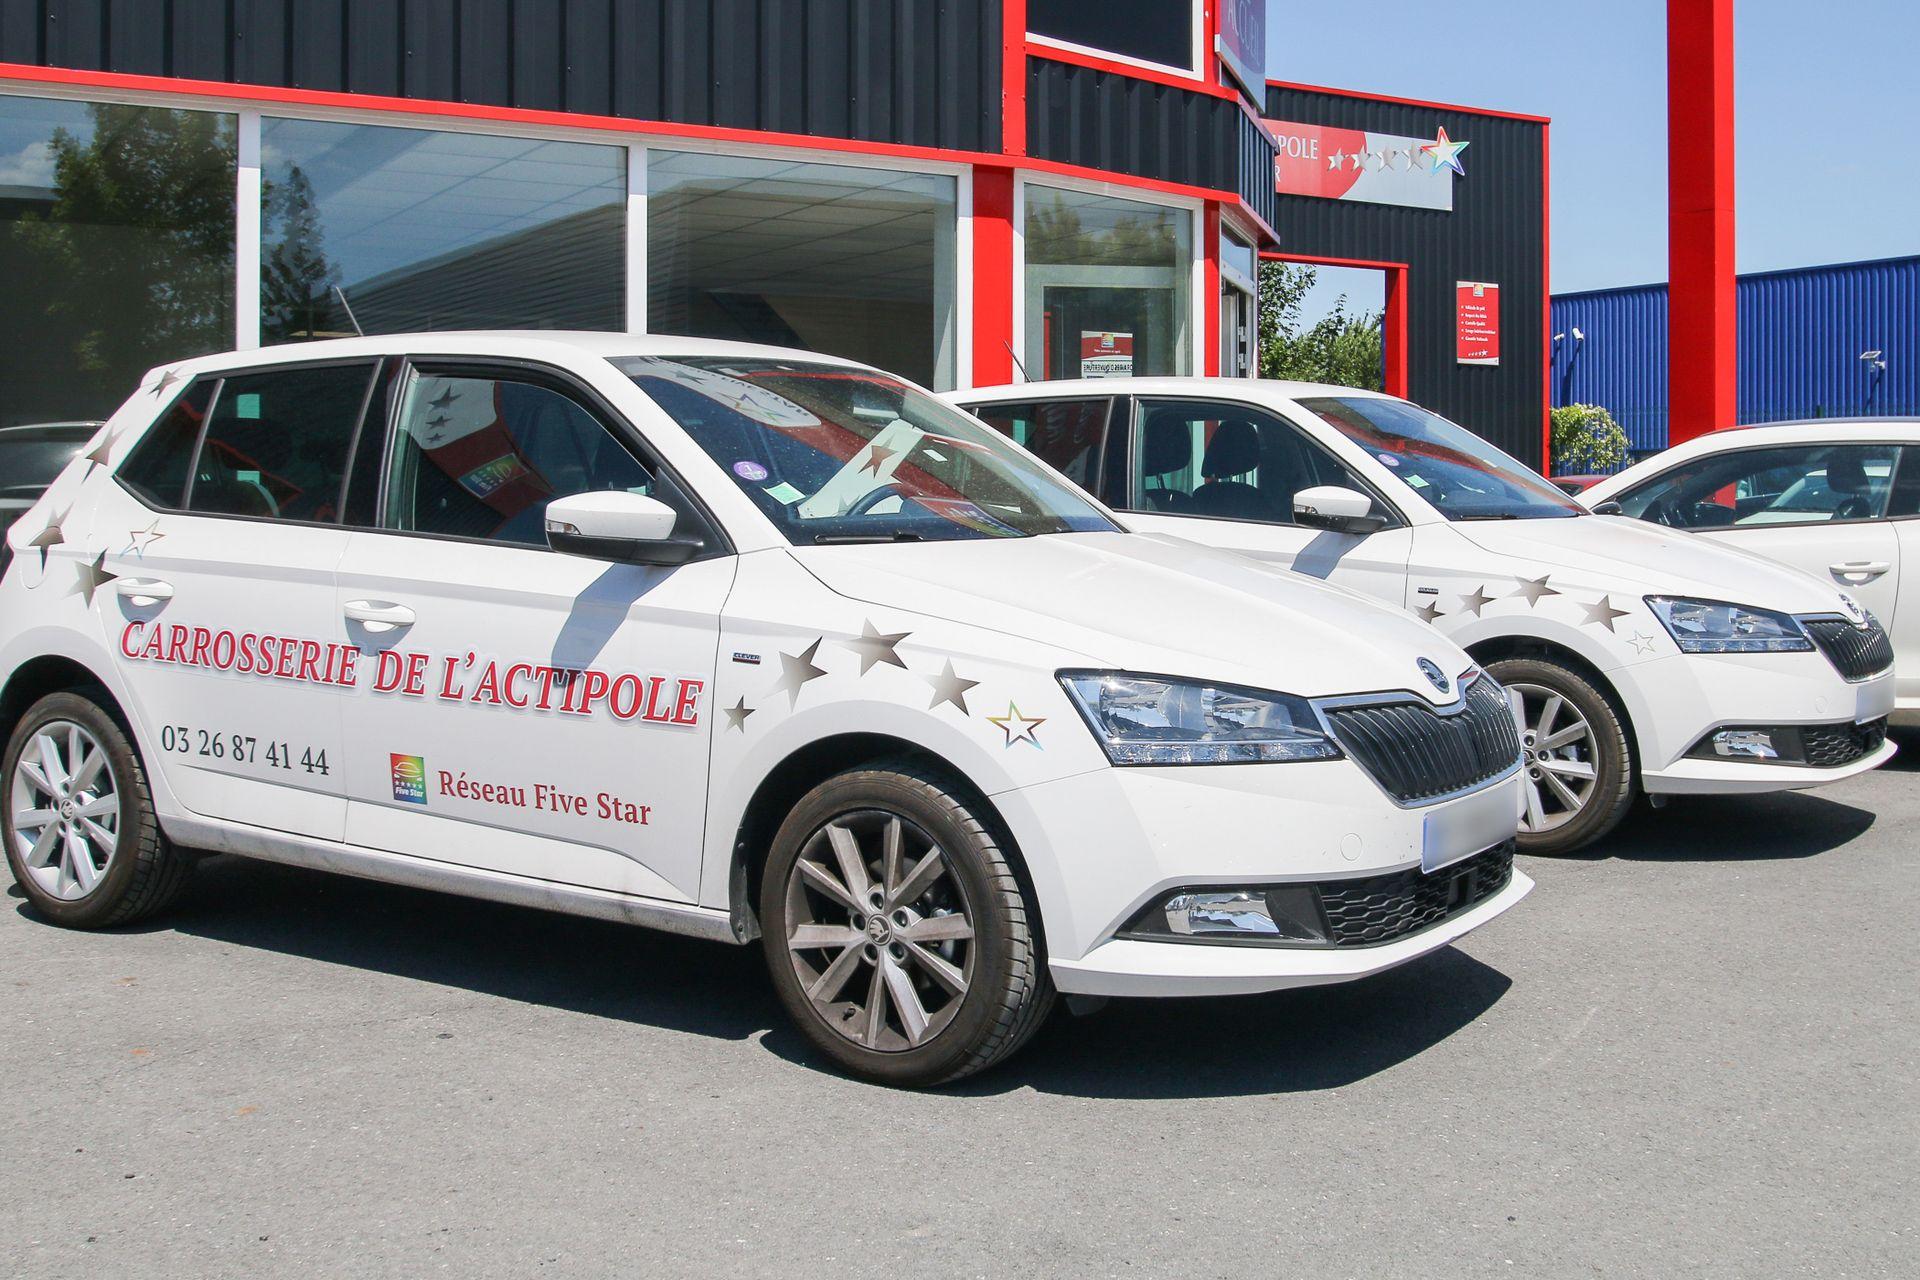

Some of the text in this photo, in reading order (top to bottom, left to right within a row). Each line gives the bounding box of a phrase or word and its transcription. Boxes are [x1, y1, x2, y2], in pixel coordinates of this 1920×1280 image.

[1272, 134, 1318, 160] POLE
[121, 620, 704, 725] CARROSSERIE DE L'ACTIPOLE
[161, 725, 330, 776] 03 26 87 41 44
[395, 786, 424, 798] Five Star
[437, 770, 652, 826] Réseau Five Star
